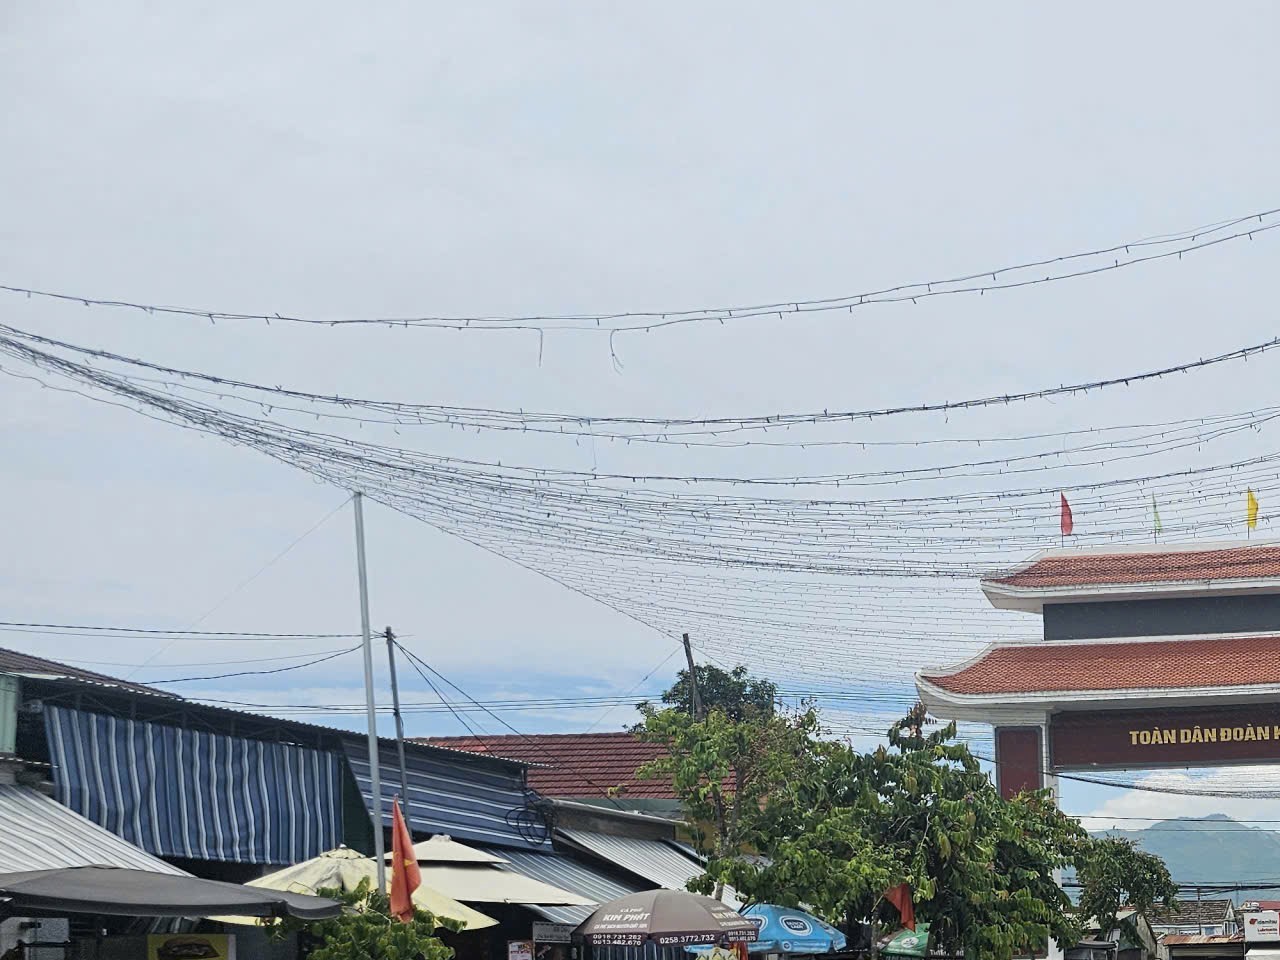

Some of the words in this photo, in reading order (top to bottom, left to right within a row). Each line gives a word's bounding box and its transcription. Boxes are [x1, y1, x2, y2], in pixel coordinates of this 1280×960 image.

[1129, 727, 1176, 745] TOÀN
[1180, 725, 1216, 743] DÂN
[1220, 724, 1270, 742] ĐOÀN
[659, 934, 715, 944] 0258.3772.732
